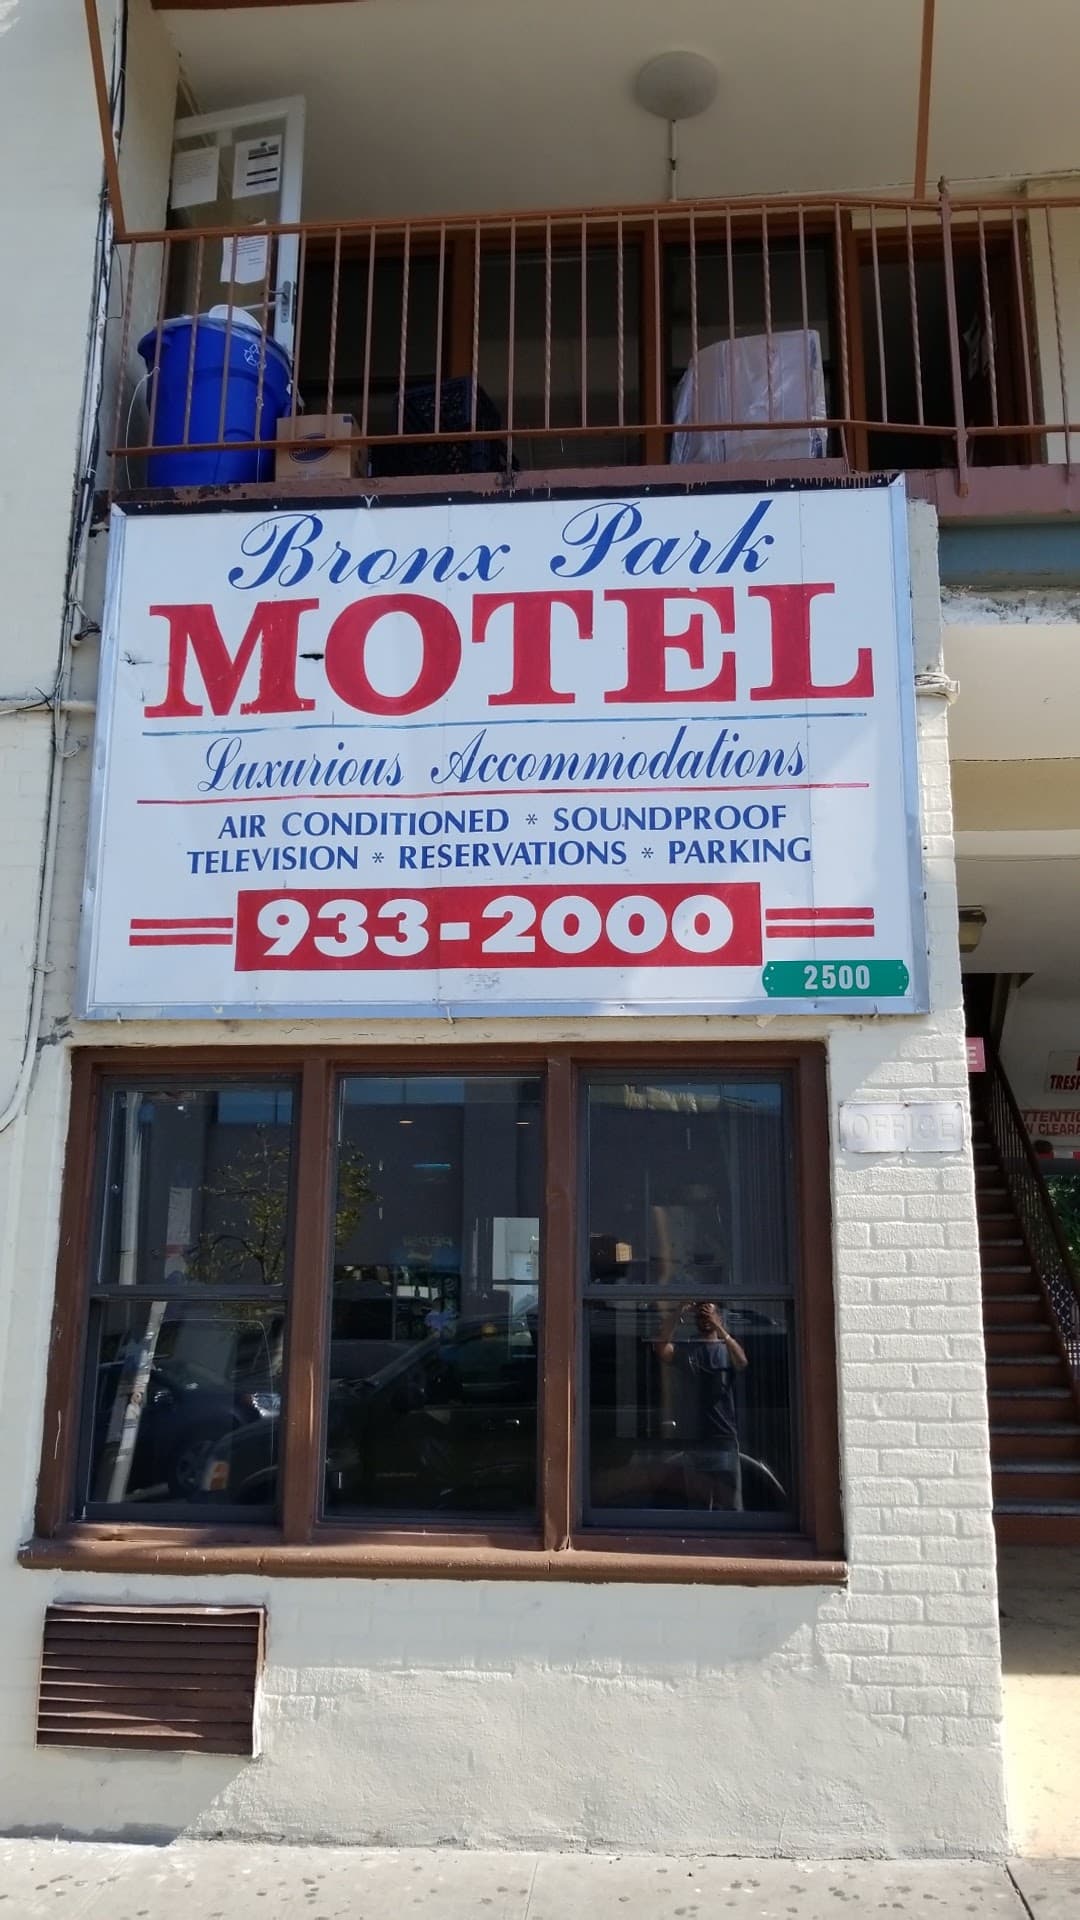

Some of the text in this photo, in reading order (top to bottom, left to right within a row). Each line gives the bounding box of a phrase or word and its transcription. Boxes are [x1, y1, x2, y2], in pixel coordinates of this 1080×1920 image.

[228, 499, 774, 590] Bronx Park
[145, 584, 873, 718] MOTEL
[198, 725, 805, 792] Luxurious Accommodations
[218, 804, 787, 839] AIR CONDITIONED SOUNDPROOF
[187, 836, 812, 875] TELEVISION RESERVATIONS PARKING
[257, 894, 734, 958] 933-2000
[804, 965, 871, 990] 2500
[850, 1113, 955, 1141] OFFICE
